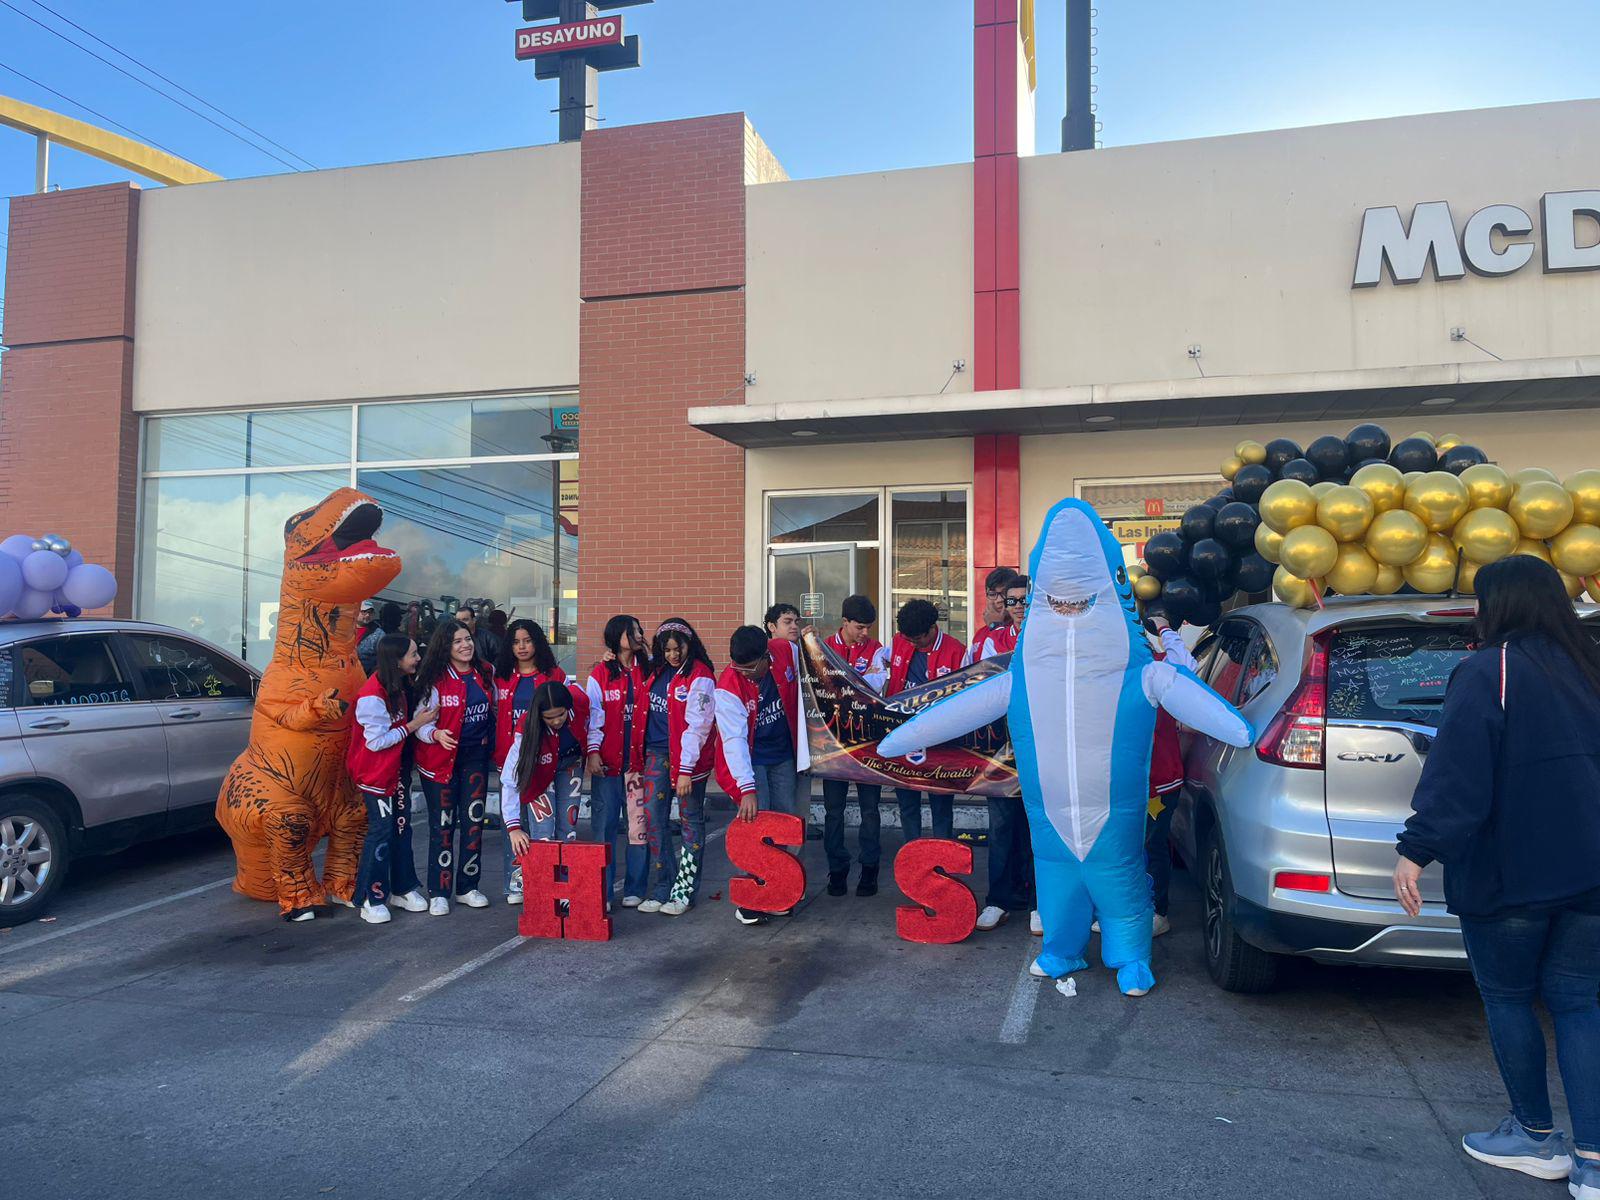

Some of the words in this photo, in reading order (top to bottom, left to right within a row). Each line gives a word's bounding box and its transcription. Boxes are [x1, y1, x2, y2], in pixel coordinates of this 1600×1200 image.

[519, 22, 616, 49] DESAYUNO
[1118, 526, 1142, 538] Las
[863, 757, 882, 770] The
[884, 761, 922, 776] Future
[923, 765, 977, 779] Awaits!
[1336, 752, 1405, 763] CR-V
[438, 789, 453, 889] ENIOR
